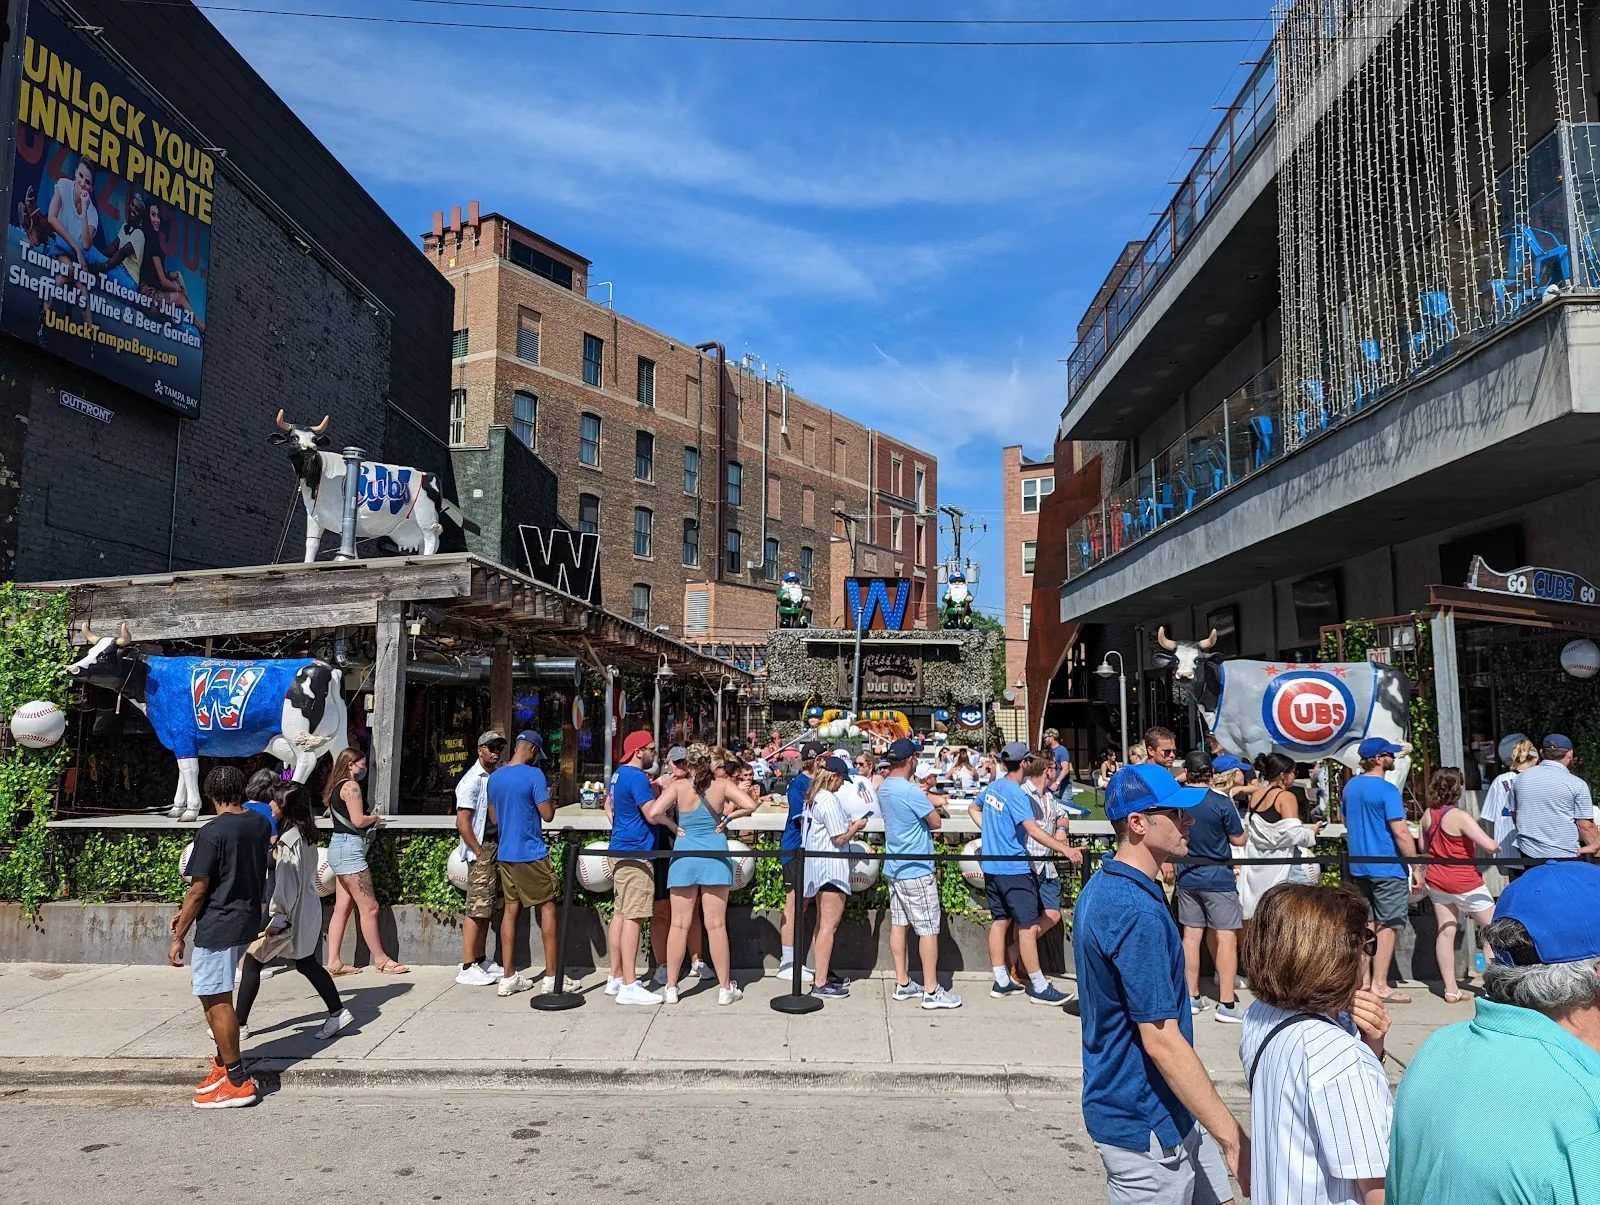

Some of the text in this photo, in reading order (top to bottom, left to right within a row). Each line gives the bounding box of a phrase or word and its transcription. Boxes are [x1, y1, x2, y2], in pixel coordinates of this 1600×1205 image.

[23, 36, 146, 147] UNLOCK
[152, 119, 214, 189] YOUR
[18, 80, 120, 175] INNER
[126, 145, 214, 225] PIRATE
[9, 265, 201, 349] Sheffield's Wine & Beer Garden
[20, 240, 195, 324] Tampa Tap Takeover July 21
[44, 309, 178, 366] UnlockTampaBay.com
[61, 393, 111, 422] OUTFRONT
[163, 385, 198, 408] TAMPA BAY
[518, 524, 600, 602] W
[1507, 570, 1596, 603] GO CUBS GO
[846, 577, 911, 631] W
[191, 667, 265, 731] W
[867, 682, 889, 692] DUG
[1277, 681, 1345, 742] CUBS
